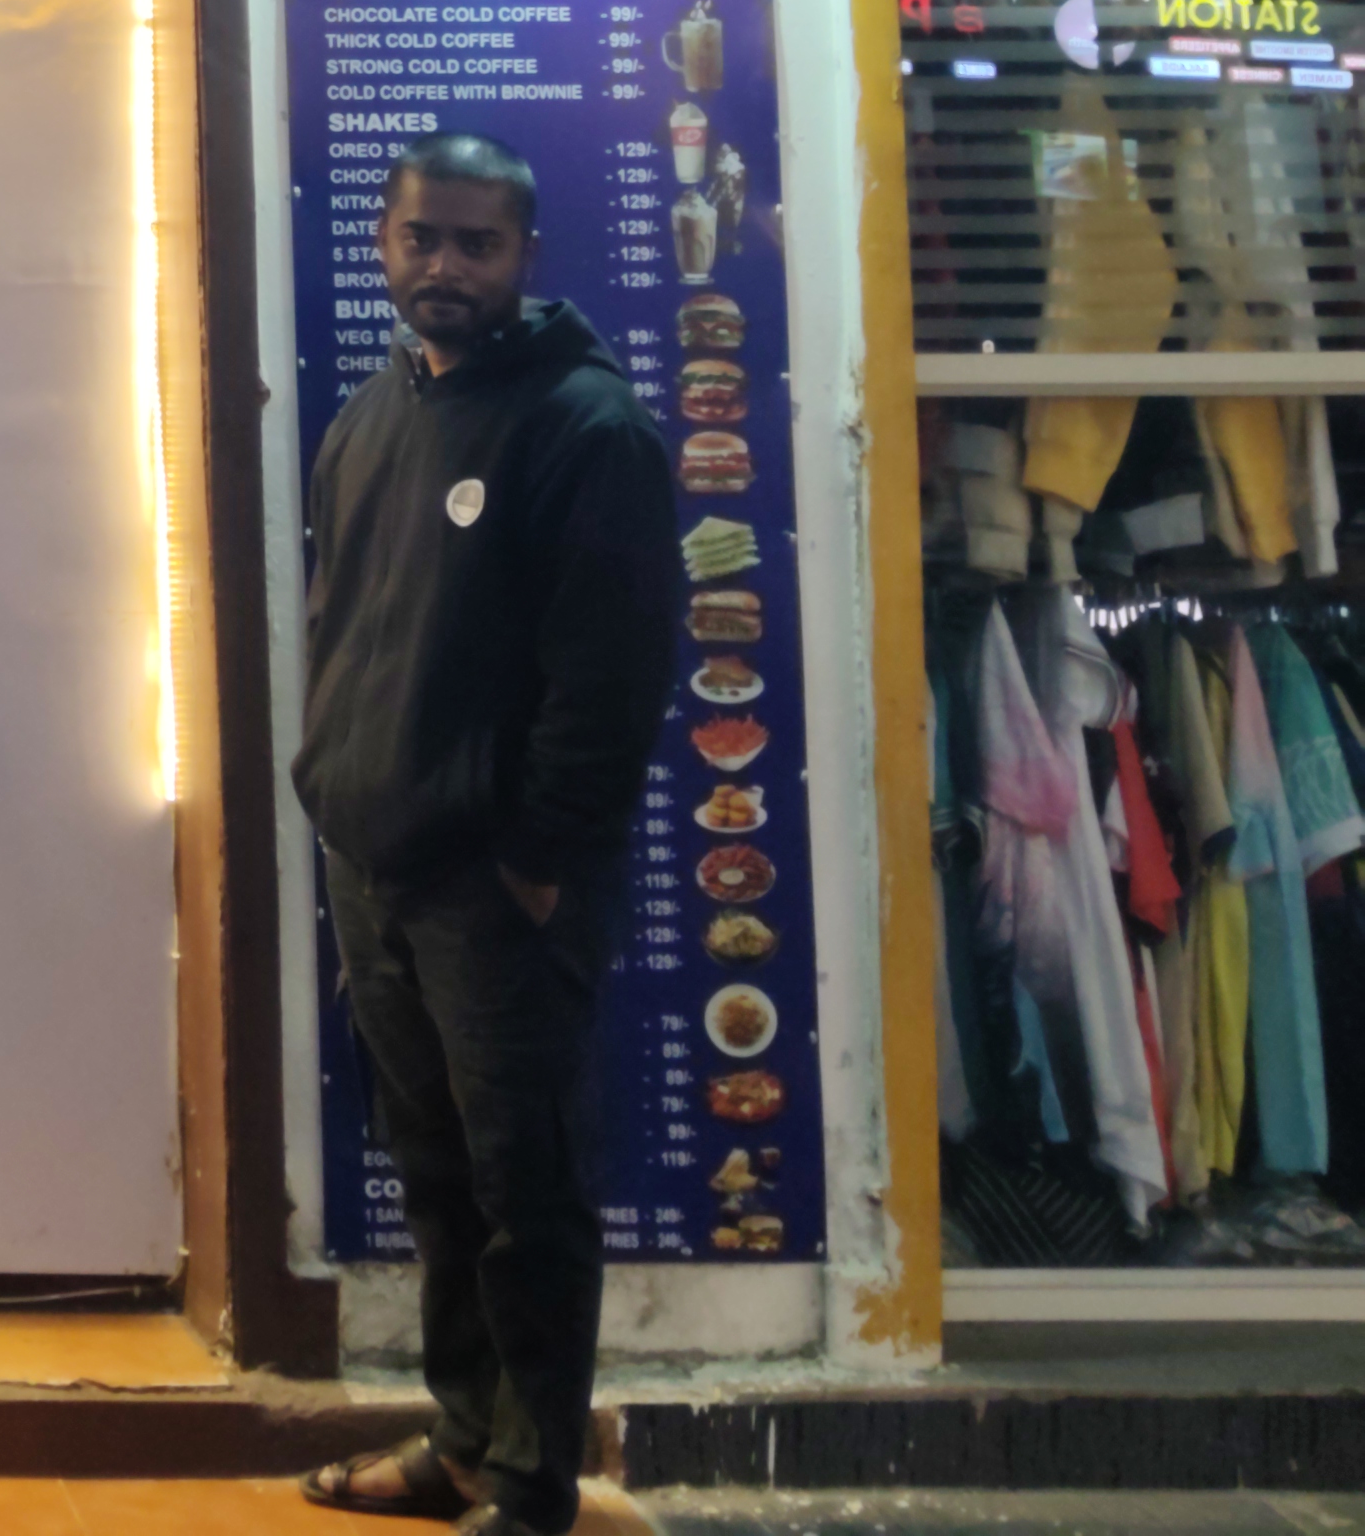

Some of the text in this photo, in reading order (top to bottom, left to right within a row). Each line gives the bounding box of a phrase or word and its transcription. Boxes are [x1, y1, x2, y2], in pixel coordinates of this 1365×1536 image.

[325, 8, 437, 22] CHOCOLATE
[442, 8, 493, 21] COLD
[498, 8, 571, 21] COFFEE
[326, 34, 380, 48] THICK
[386, 34, 437, 48] COLD
[442, 34, 515, 48] COFFEE
[326, 60, 404, 74] STRONG
[408, 60, 459, 73] COLD
[464, 60, 537, 73] COFFEE
[327, 86, 375, 100] COLD
[380, 86, 449, 100] COFFEE
[453, 86, 497, 99] WITH
[501, 86, 582, 99] BROWNIE
[329, 113, 437, 131] SHAKES
[329, 144, 383, 158] OREO
[331, 196, 385, 209] KITKA
[333, 248, 343, 262] 5
[348, 248, 383, 262] STA
[336, 331, 373, 345] VEG
